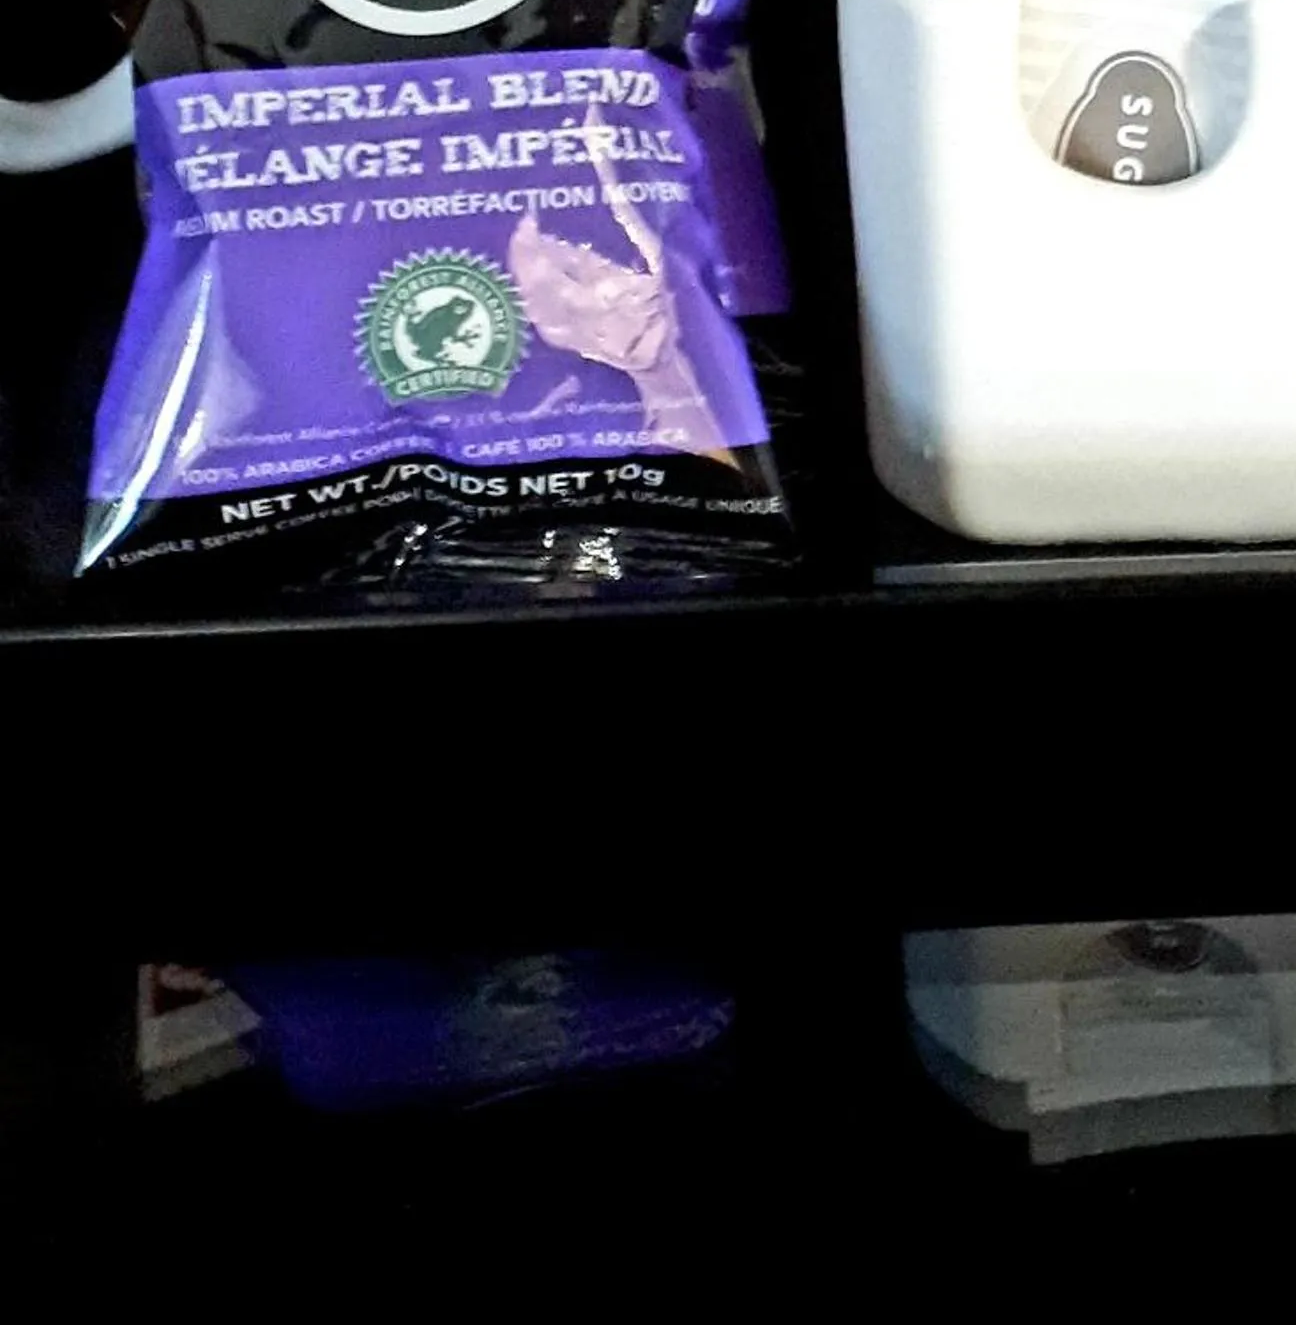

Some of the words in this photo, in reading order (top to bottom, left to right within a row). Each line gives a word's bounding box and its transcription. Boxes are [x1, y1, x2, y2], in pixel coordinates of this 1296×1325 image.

[177, 77, 471, 134] IMPERIAL
[488, 68, 661, 108] BLEND
[175, 137, 424, 193] ÉLANGE
[440, 117, 685, 173] IMPÉRIAL
[1112, 93, 1154, 182] SUG
[246, 202, 346, 230] ROAST
[370, 185, 596, 223] TORRÉFACTION
[602, 180, 690, 209] MOYEN
[220, 493, 298, 524] NET
[519, 472, 595, 498] NET
[603, 462, 666, 487] 10g
[243, 453, 347, 479] ARABICA
[118, 537, 197, 568] SINGLE
